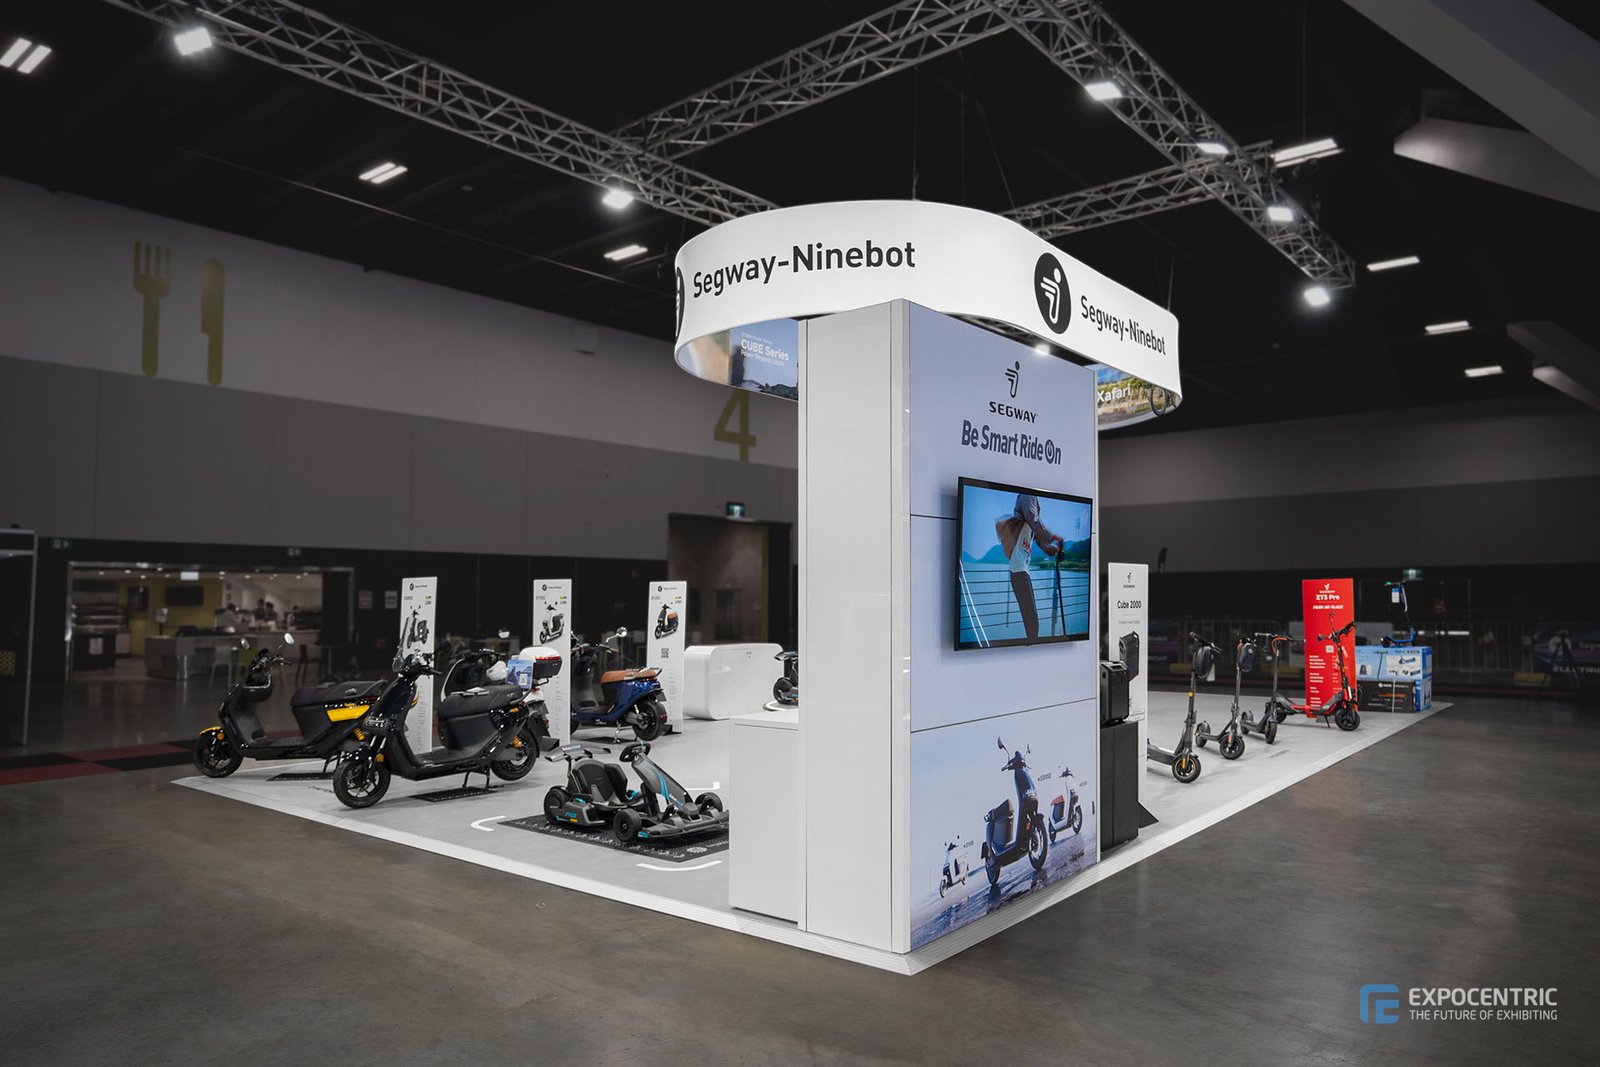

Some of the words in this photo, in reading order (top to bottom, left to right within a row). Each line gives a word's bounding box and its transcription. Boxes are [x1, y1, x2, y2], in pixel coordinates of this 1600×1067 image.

[693, 239, 916, 298] Segway-Ninebot
[1080, 294, 1166, 356] Segway-Ninebot
[741, 338, 764, 354] CUBE
[765, 345, 790, 361] Series
[713, 387, 757, 464] 4
[988, 401, 1037, 424] SEGWAY
[961, 419, 979, 448] Be
[980, 424, 1019, 456] Smart
[1019, 433, 1044, 461] Ride
[1044, 439, 1062, 465] On
[1117, 600, 1129, 609] Cube
[1130, 600, 1142, 609] 2000
